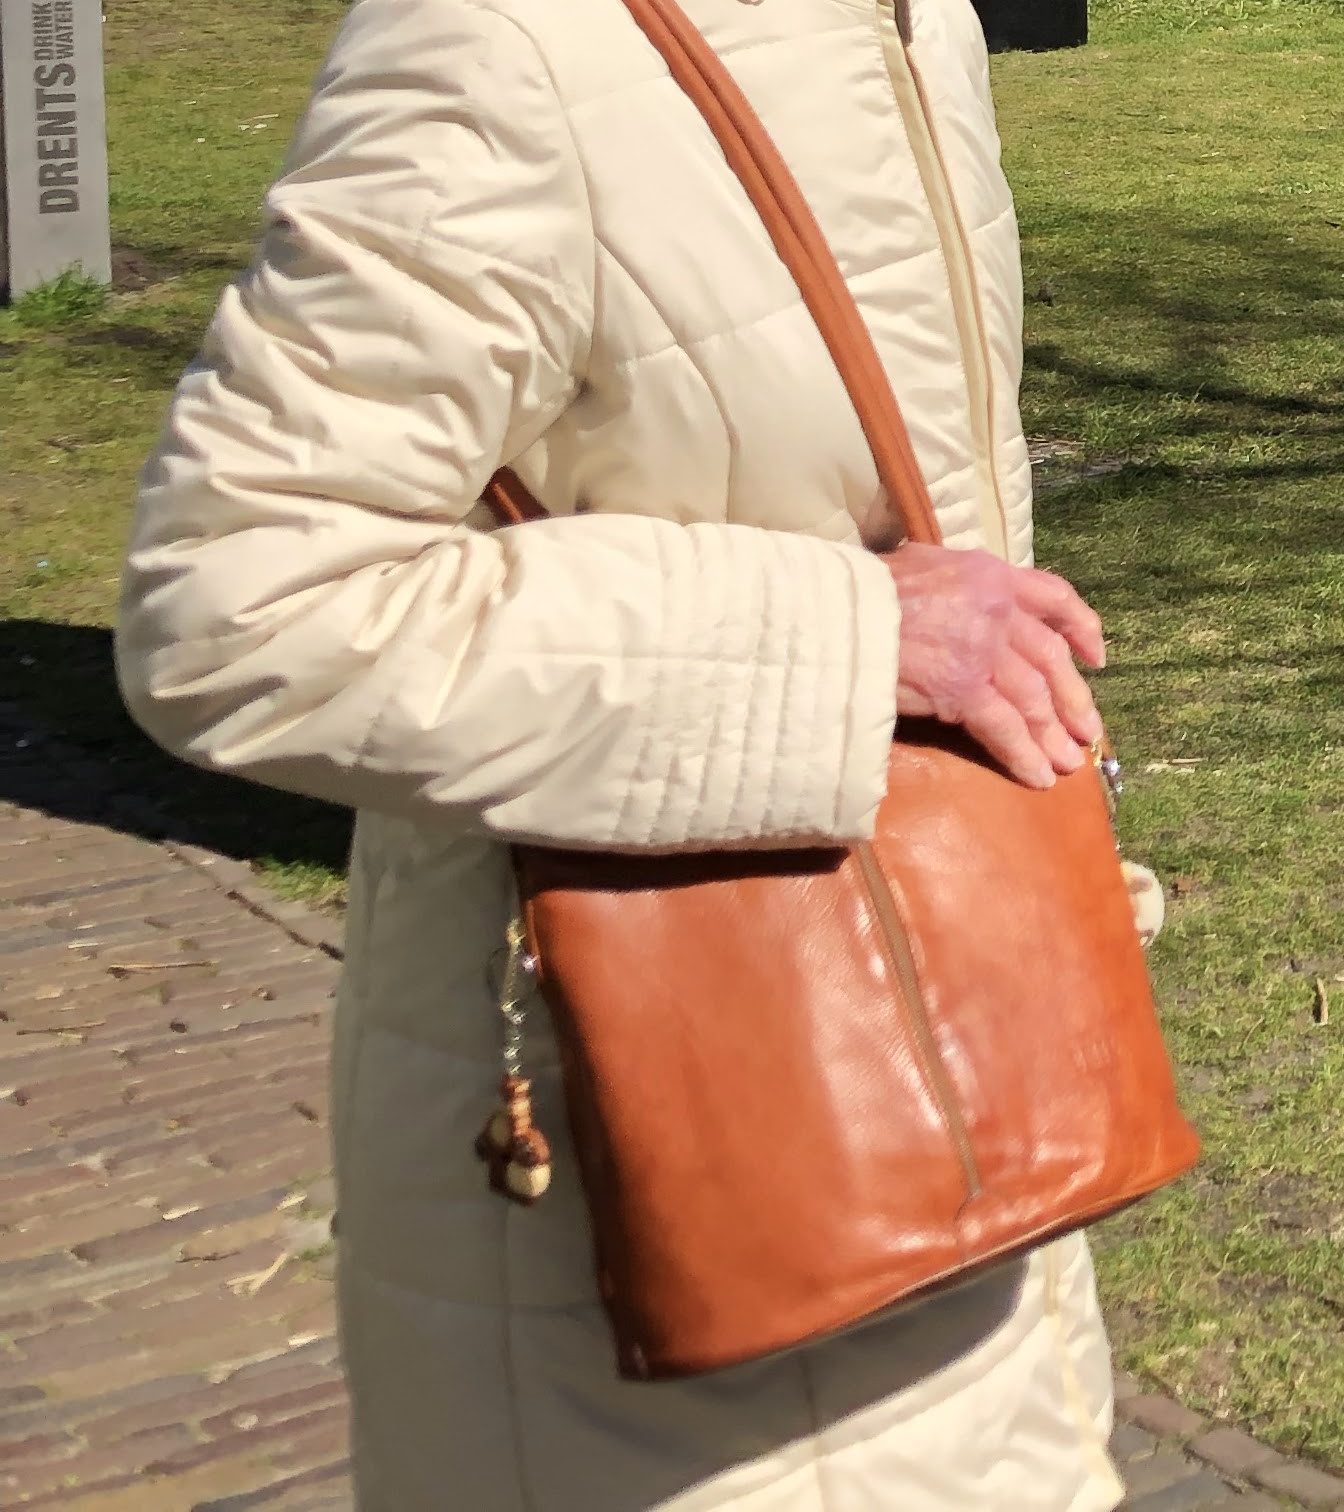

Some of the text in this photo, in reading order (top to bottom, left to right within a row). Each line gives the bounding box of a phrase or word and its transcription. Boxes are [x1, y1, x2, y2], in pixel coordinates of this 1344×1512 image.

[32, 0, 54, 61] DRINK
[55, 0, 74, 60] WATER
[34, 62, 80, 215] DRENTS
